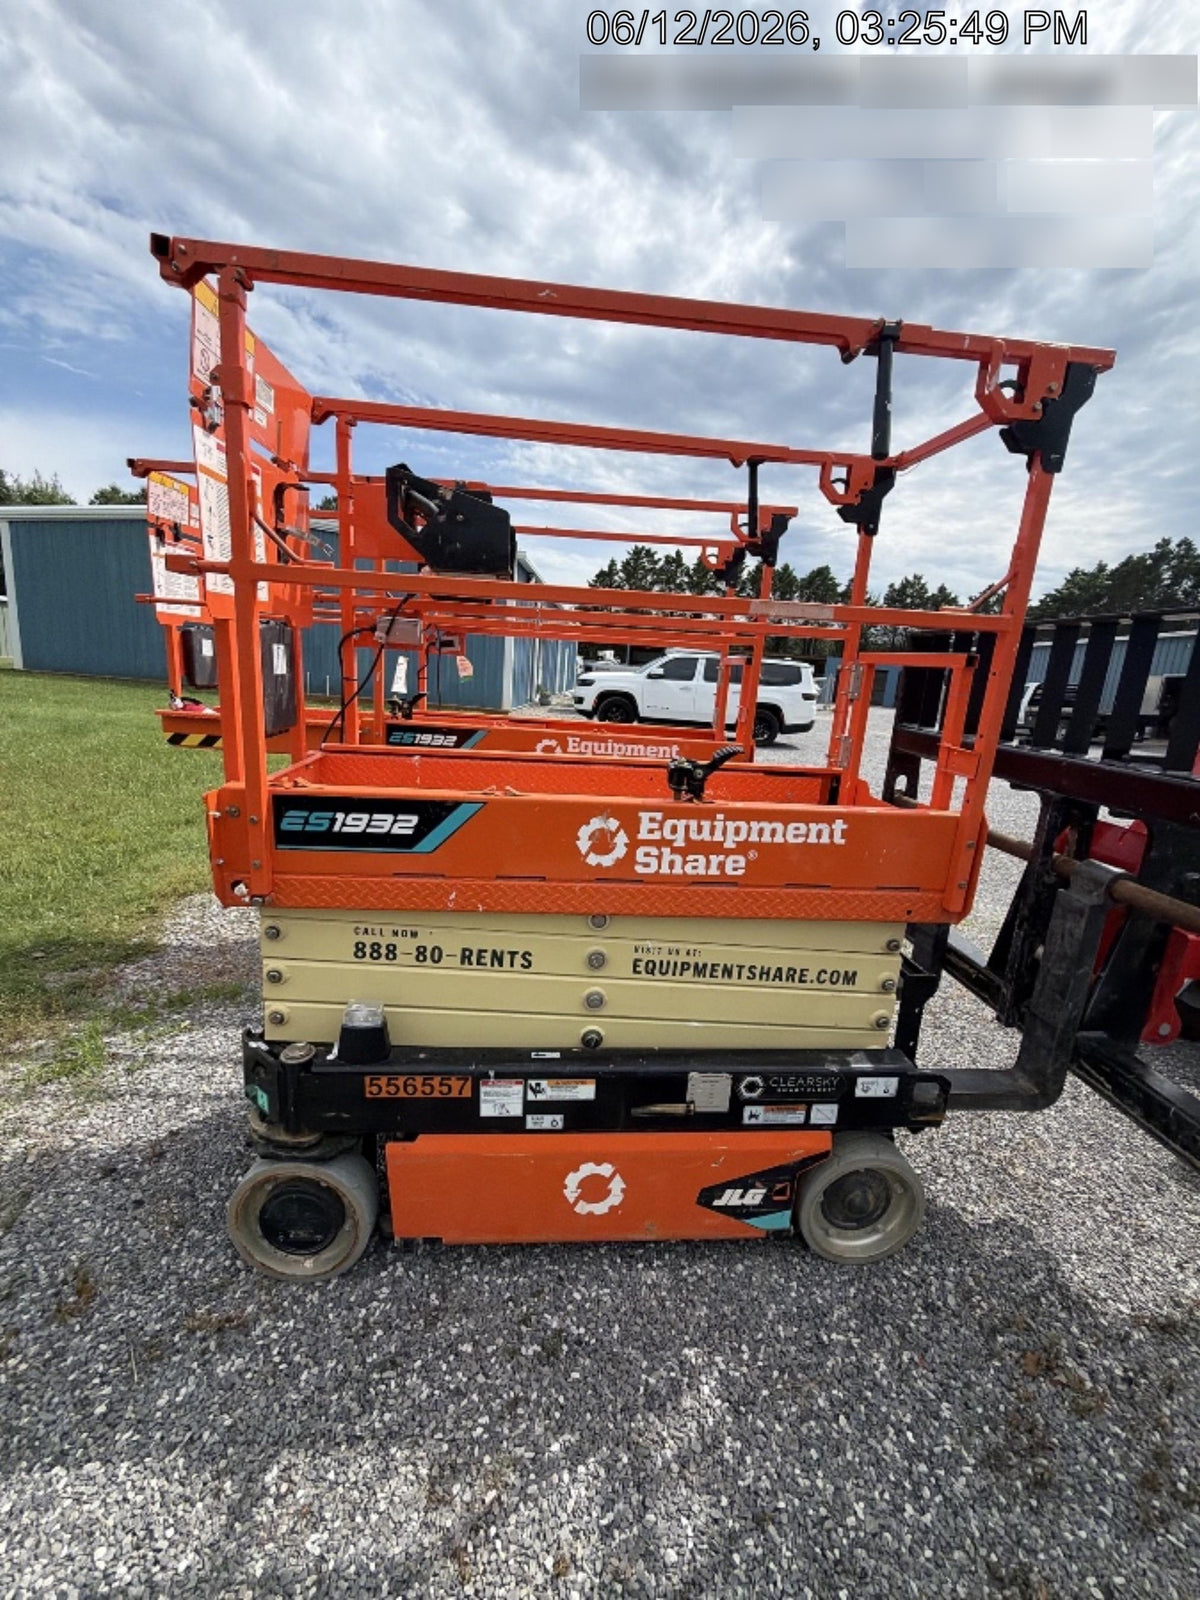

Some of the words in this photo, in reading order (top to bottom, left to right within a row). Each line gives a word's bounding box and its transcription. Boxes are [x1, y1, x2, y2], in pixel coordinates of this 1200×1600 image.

[388, 732, 458, 747] ES1932
[566, 736, 681, 759] Equipment
[280, 810, 419, 835] ES1932
[637, 811, 848, 848] Equipment
[353, 926, 385, 937] CALL
[392, 929, 419, 939] NOW
[353, 941, 533, 969] 888-80-RENTS
[632, 957, 858, 986] EQUIPMENTSHARE.COM
[368, 1076, 470, 1096] 556557
[769, 1076, 840, 1087] CLEARSKY
[712, 1188, 767, 1206] JLG
